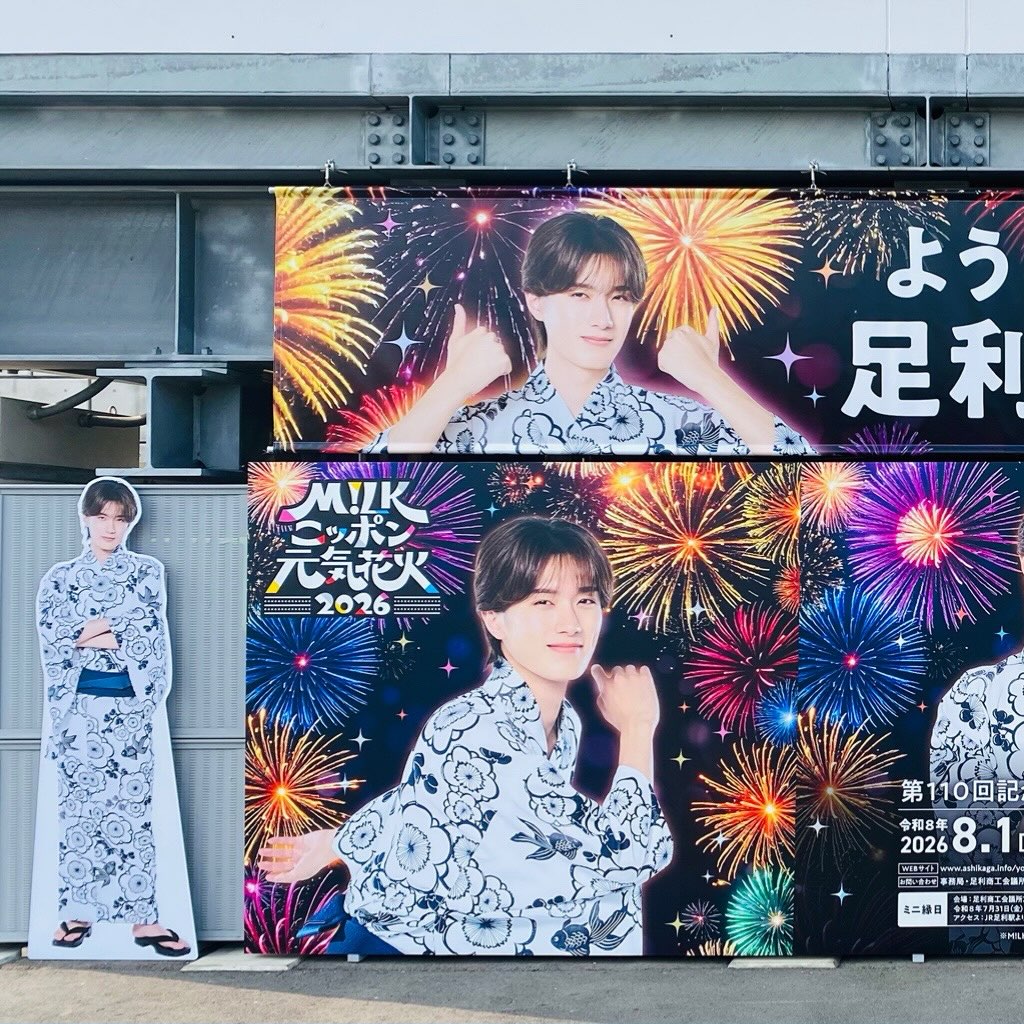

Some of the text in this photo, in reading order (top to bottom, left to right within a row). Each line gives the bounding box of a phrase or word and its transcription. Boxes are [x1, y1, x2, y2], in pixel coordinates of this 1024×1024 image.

[291, 514, 416, 548] ニッポン
[265, 546, 439, 593] 元気花火
[314, 592, 390, 614] 2026
[899, 818, 948, 831] 令和8年
[952, 816, 1010, 853] 8.1
[900, 836, 948, 853] 2026
[901, 864, 935, 872] WEBサイト
[899, 877, 938, 886] お問い合わせ
[903, 904, 942, 915] ミニ縁日
